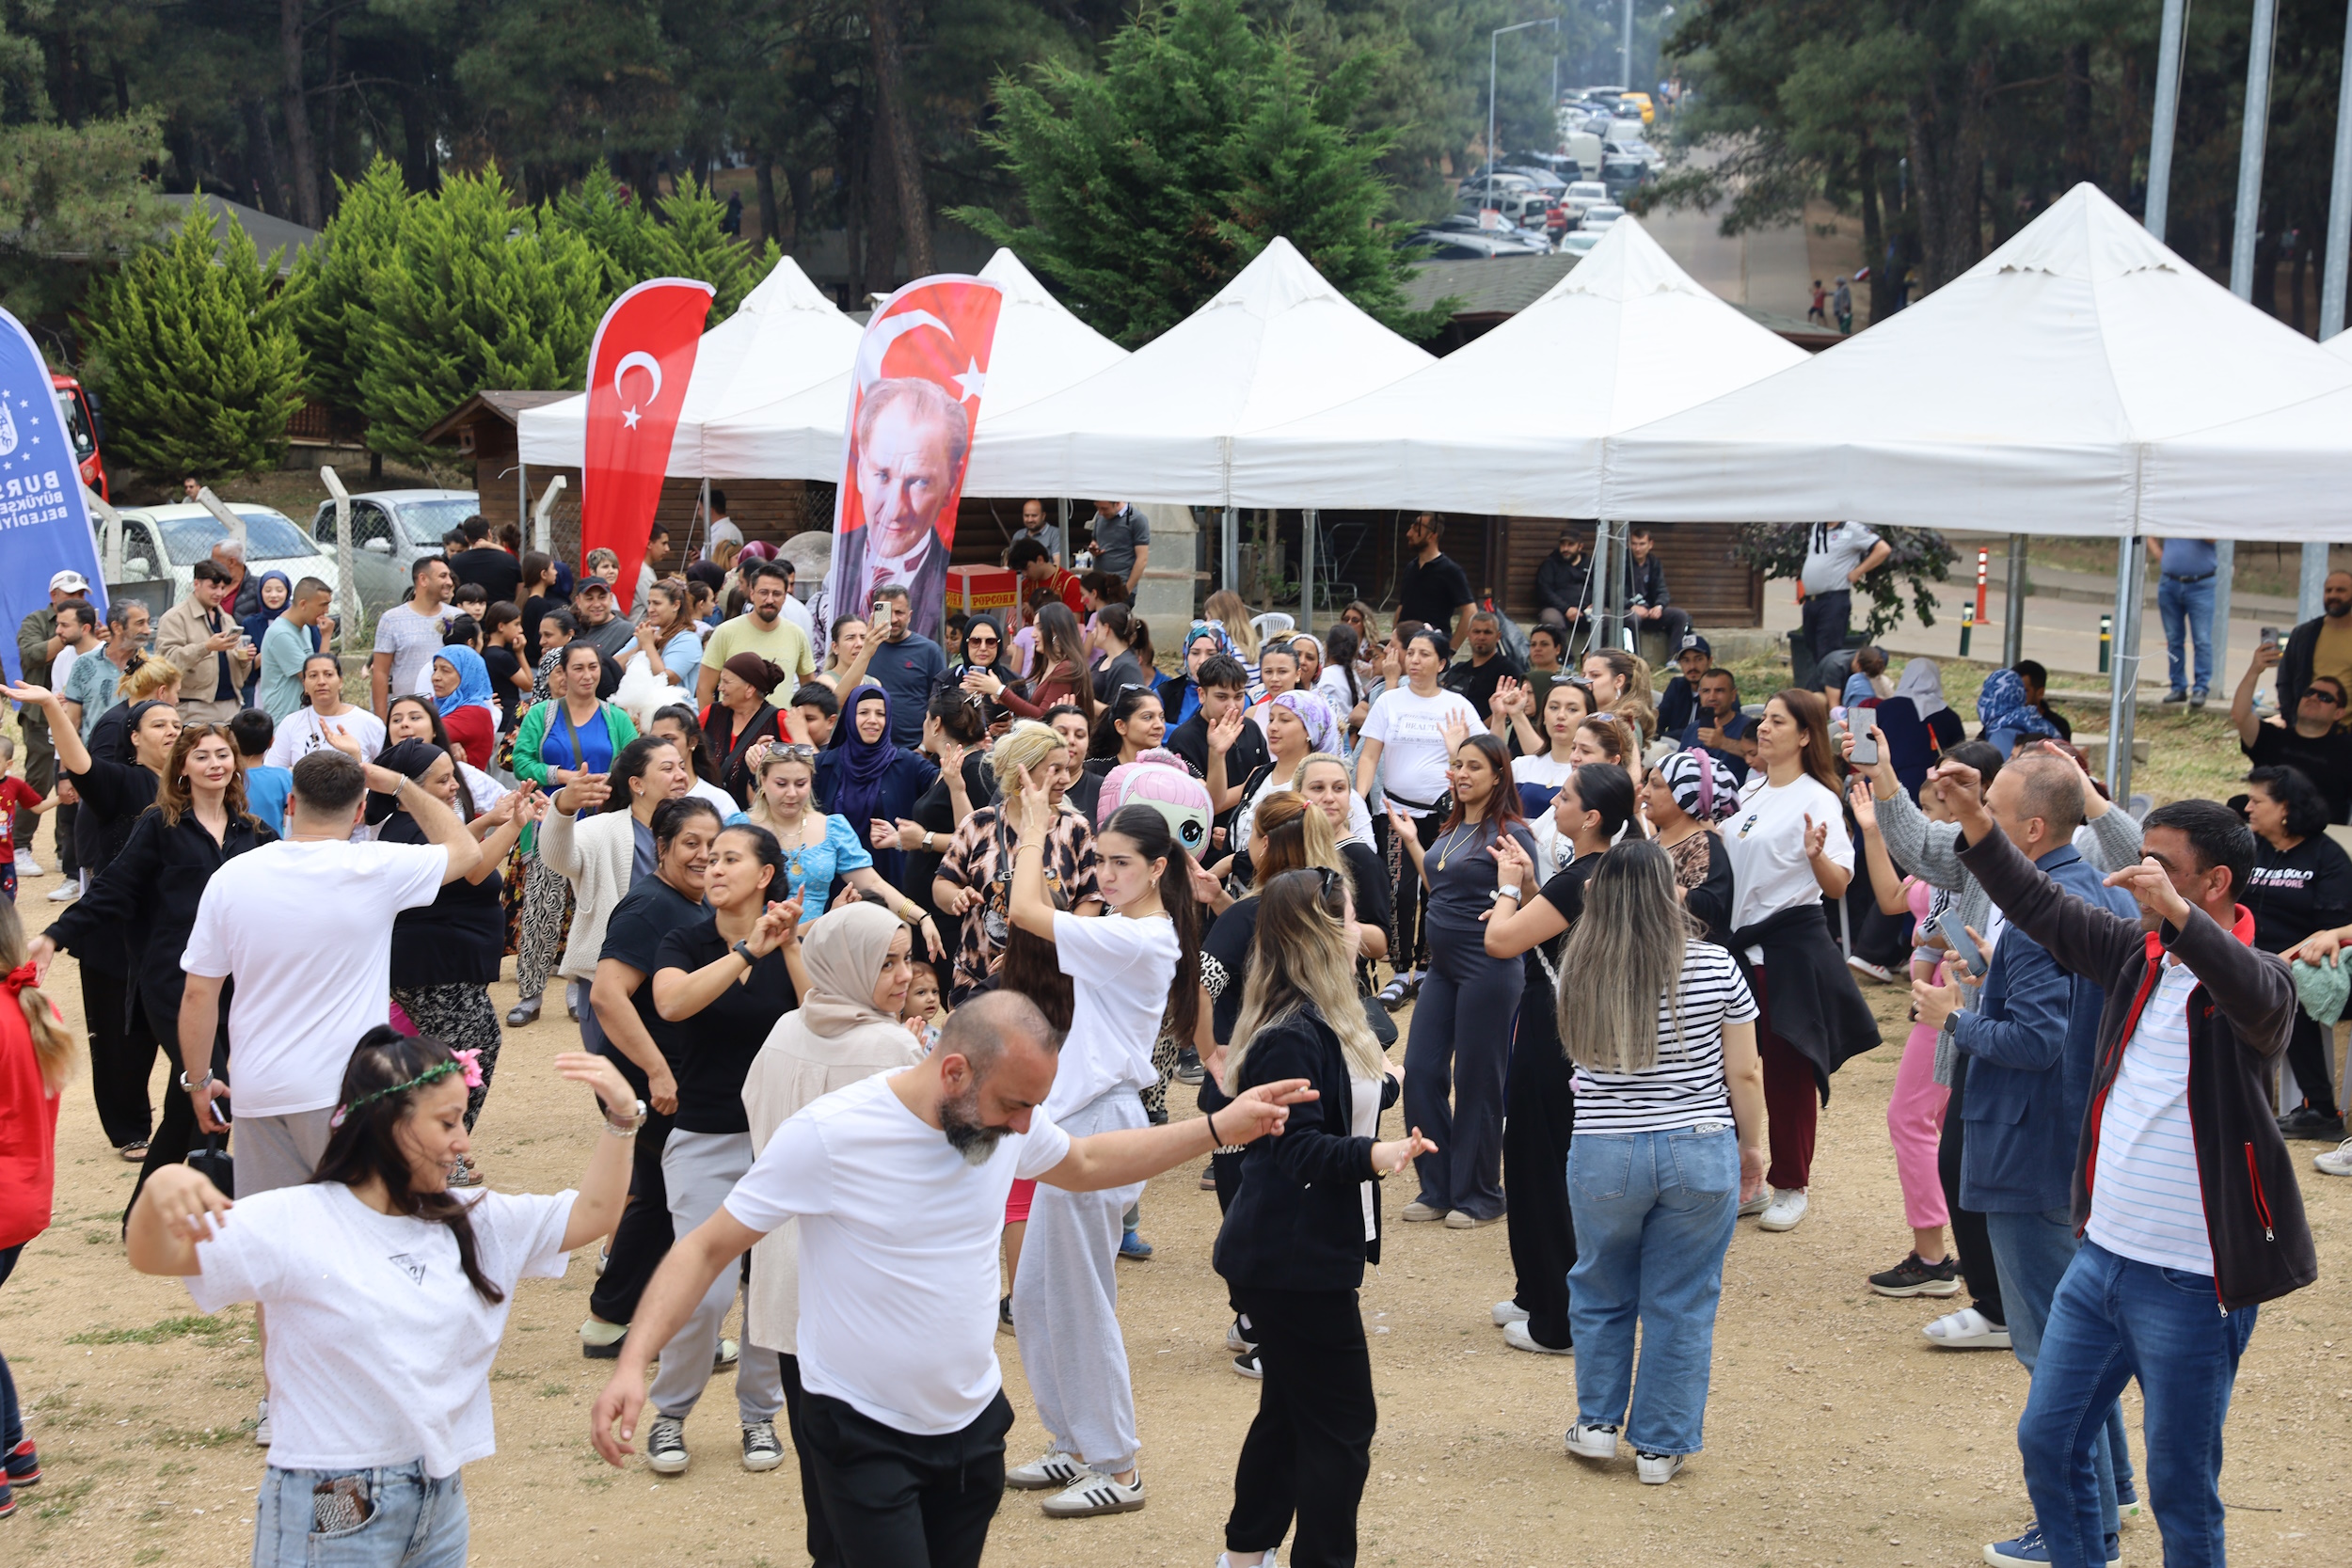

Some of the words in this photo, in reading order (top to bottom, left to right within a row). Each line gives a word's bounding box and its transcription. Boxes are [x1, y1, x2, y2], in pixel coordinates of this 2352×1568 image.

[972, 594, 1016, 607] POPCORN
[1405, 721, 1441, 732] BEAUT
[2268, 879, 2304, 889] BEFORE
